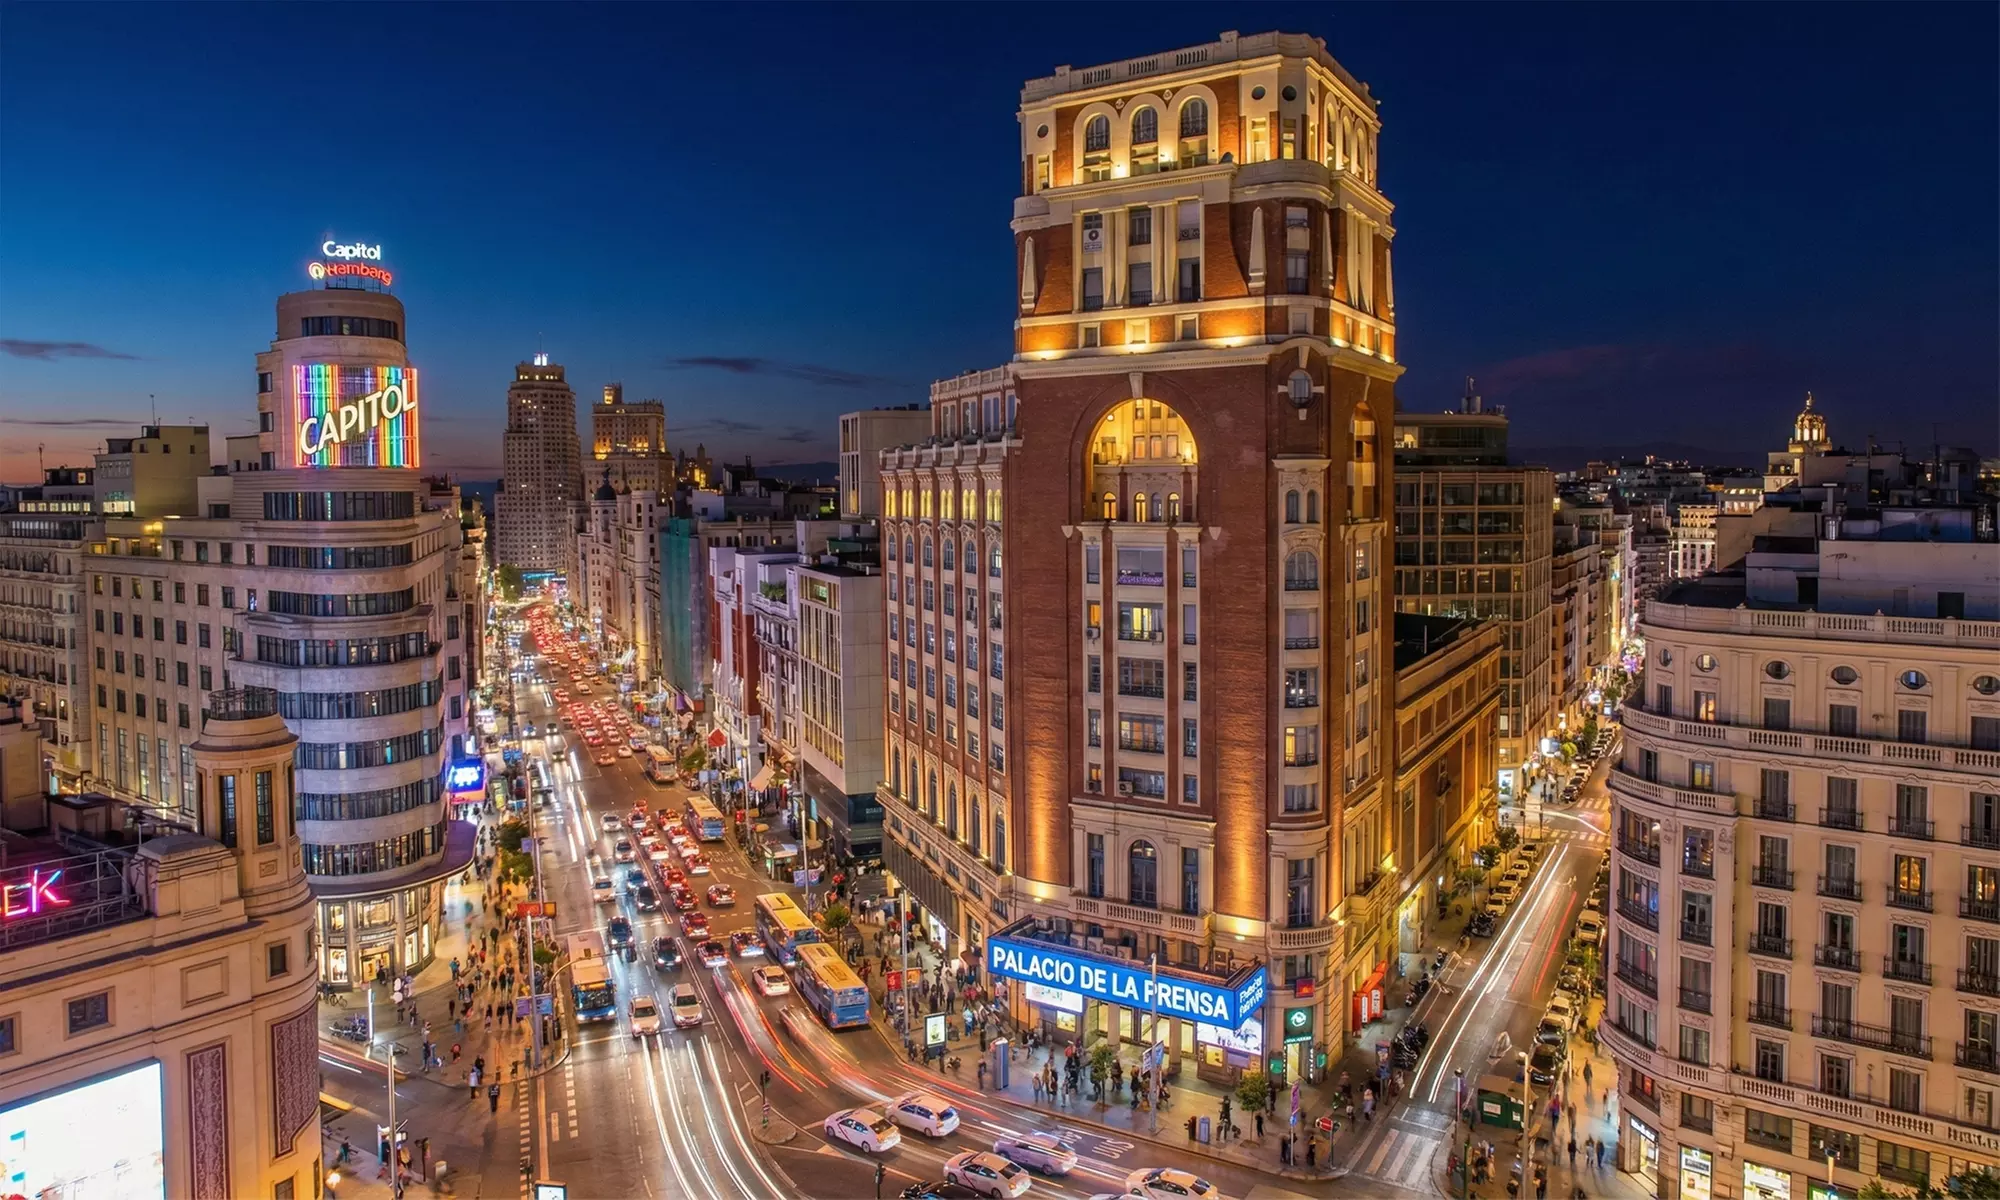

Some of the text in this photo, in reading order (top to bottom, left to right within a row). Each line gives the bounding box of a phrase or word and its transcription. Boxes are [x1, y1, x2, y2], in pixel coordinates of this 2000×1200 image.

[322, 241, 381, 261] Capitol
[300, 378, 417, 455] CAPITOL
[993, 946, 1075, 985] PALACIO
[1080, 965, 1107, 993] DE
[1112, 972, 1139, 1001] LA
[1144, 979, 1229, 1021] PRENSA
